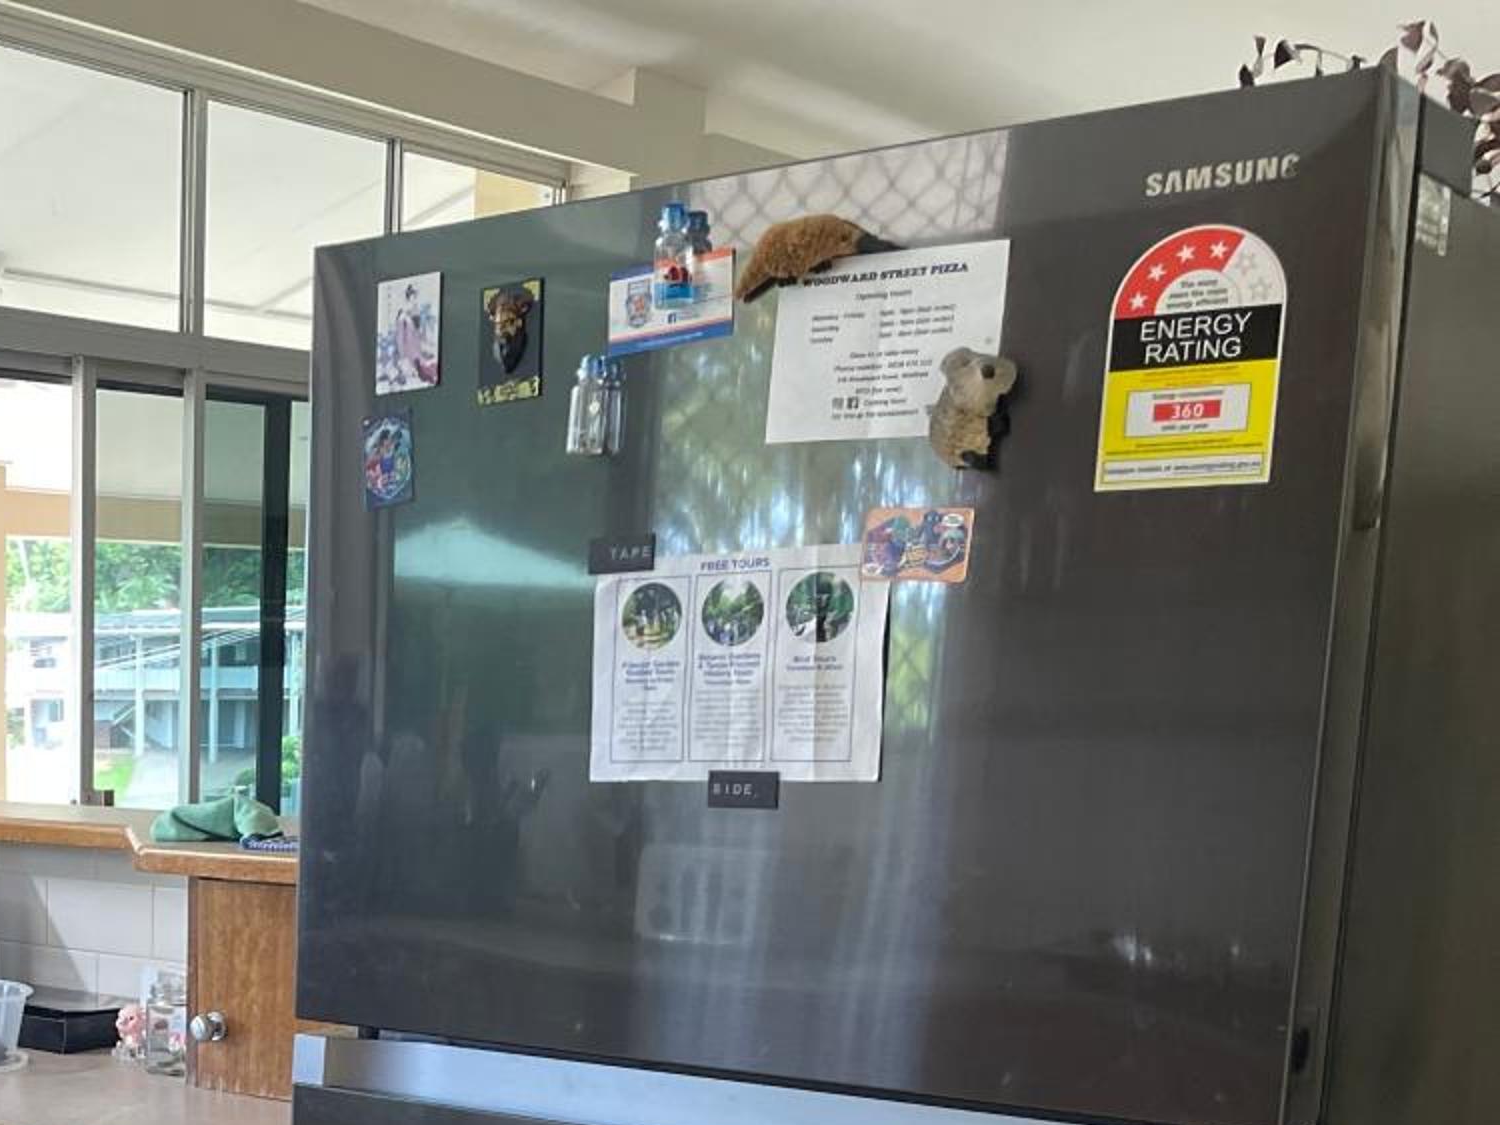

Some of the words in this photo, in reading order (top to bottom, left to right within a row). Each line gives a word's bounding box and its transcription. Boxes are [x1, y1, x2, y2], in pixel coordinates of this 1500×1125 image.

[1145, 153, 1300, 197] SAMSUNG
[804, 271, 878, 287] WOODWARD
[880, 266, 927, 280] STREET
[930, 263, 968, 275] PIZZA
[1139, 311, 1253, 342] ENERGY
[1144, 335, 1242, 365] RATING
[1171, 403, 1205, 420] 360
[610, 546, 651, 561] TAPE
[701, 559, 729, 571] FREE
[732, 557, 771, 570] TOURS
